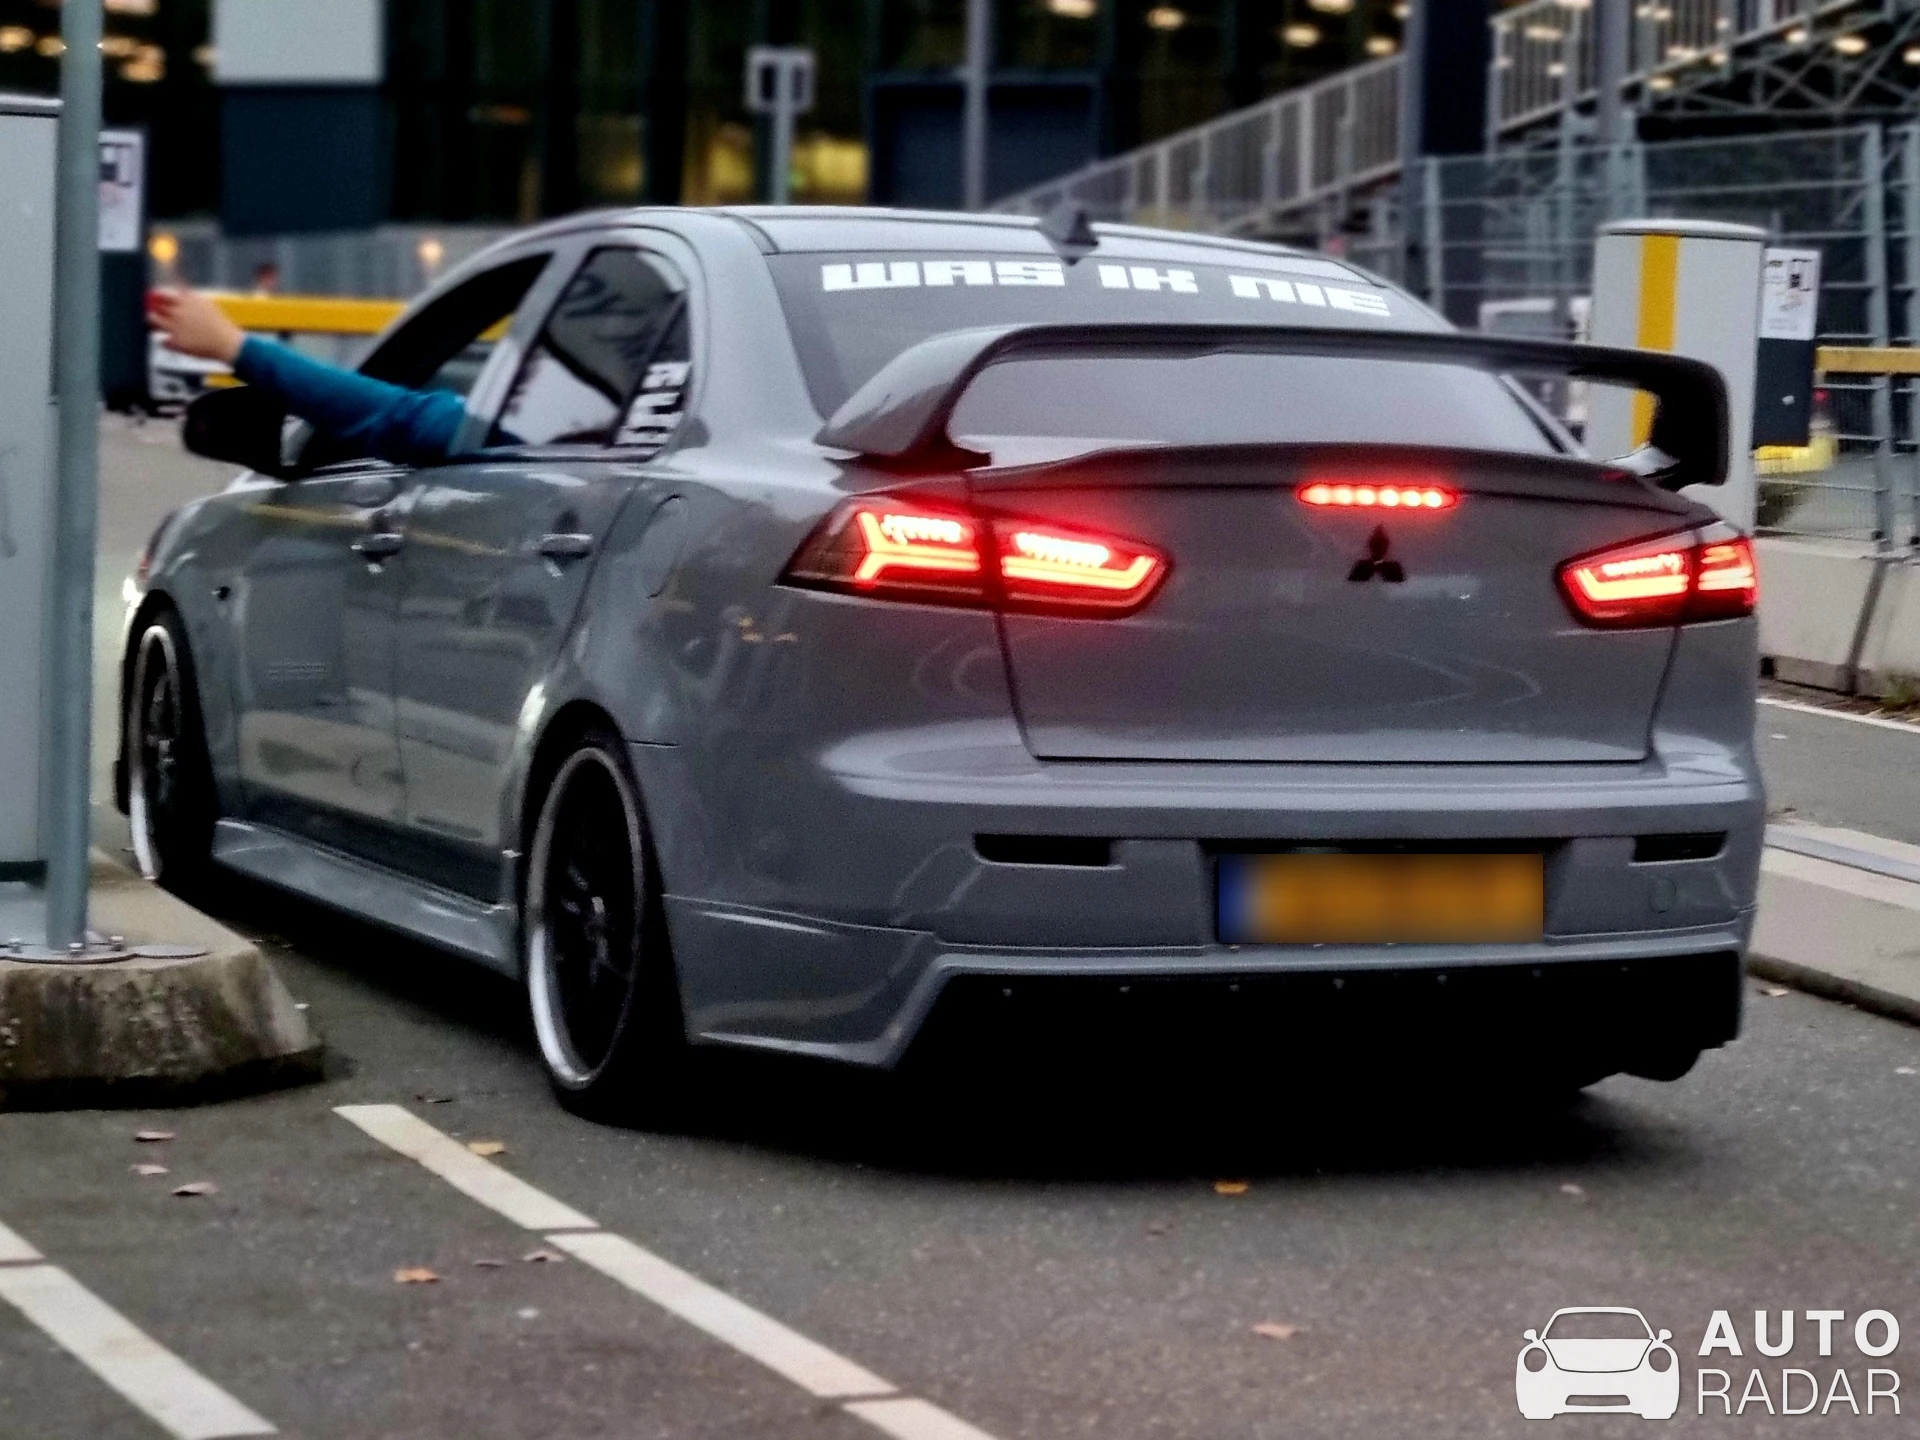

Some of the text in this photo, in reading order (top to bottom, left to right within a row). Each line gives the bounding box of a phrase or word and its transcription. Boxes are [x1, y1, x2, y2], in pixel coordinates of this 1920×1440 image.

[822, 260, 1391, 317] WAS IK NIE
